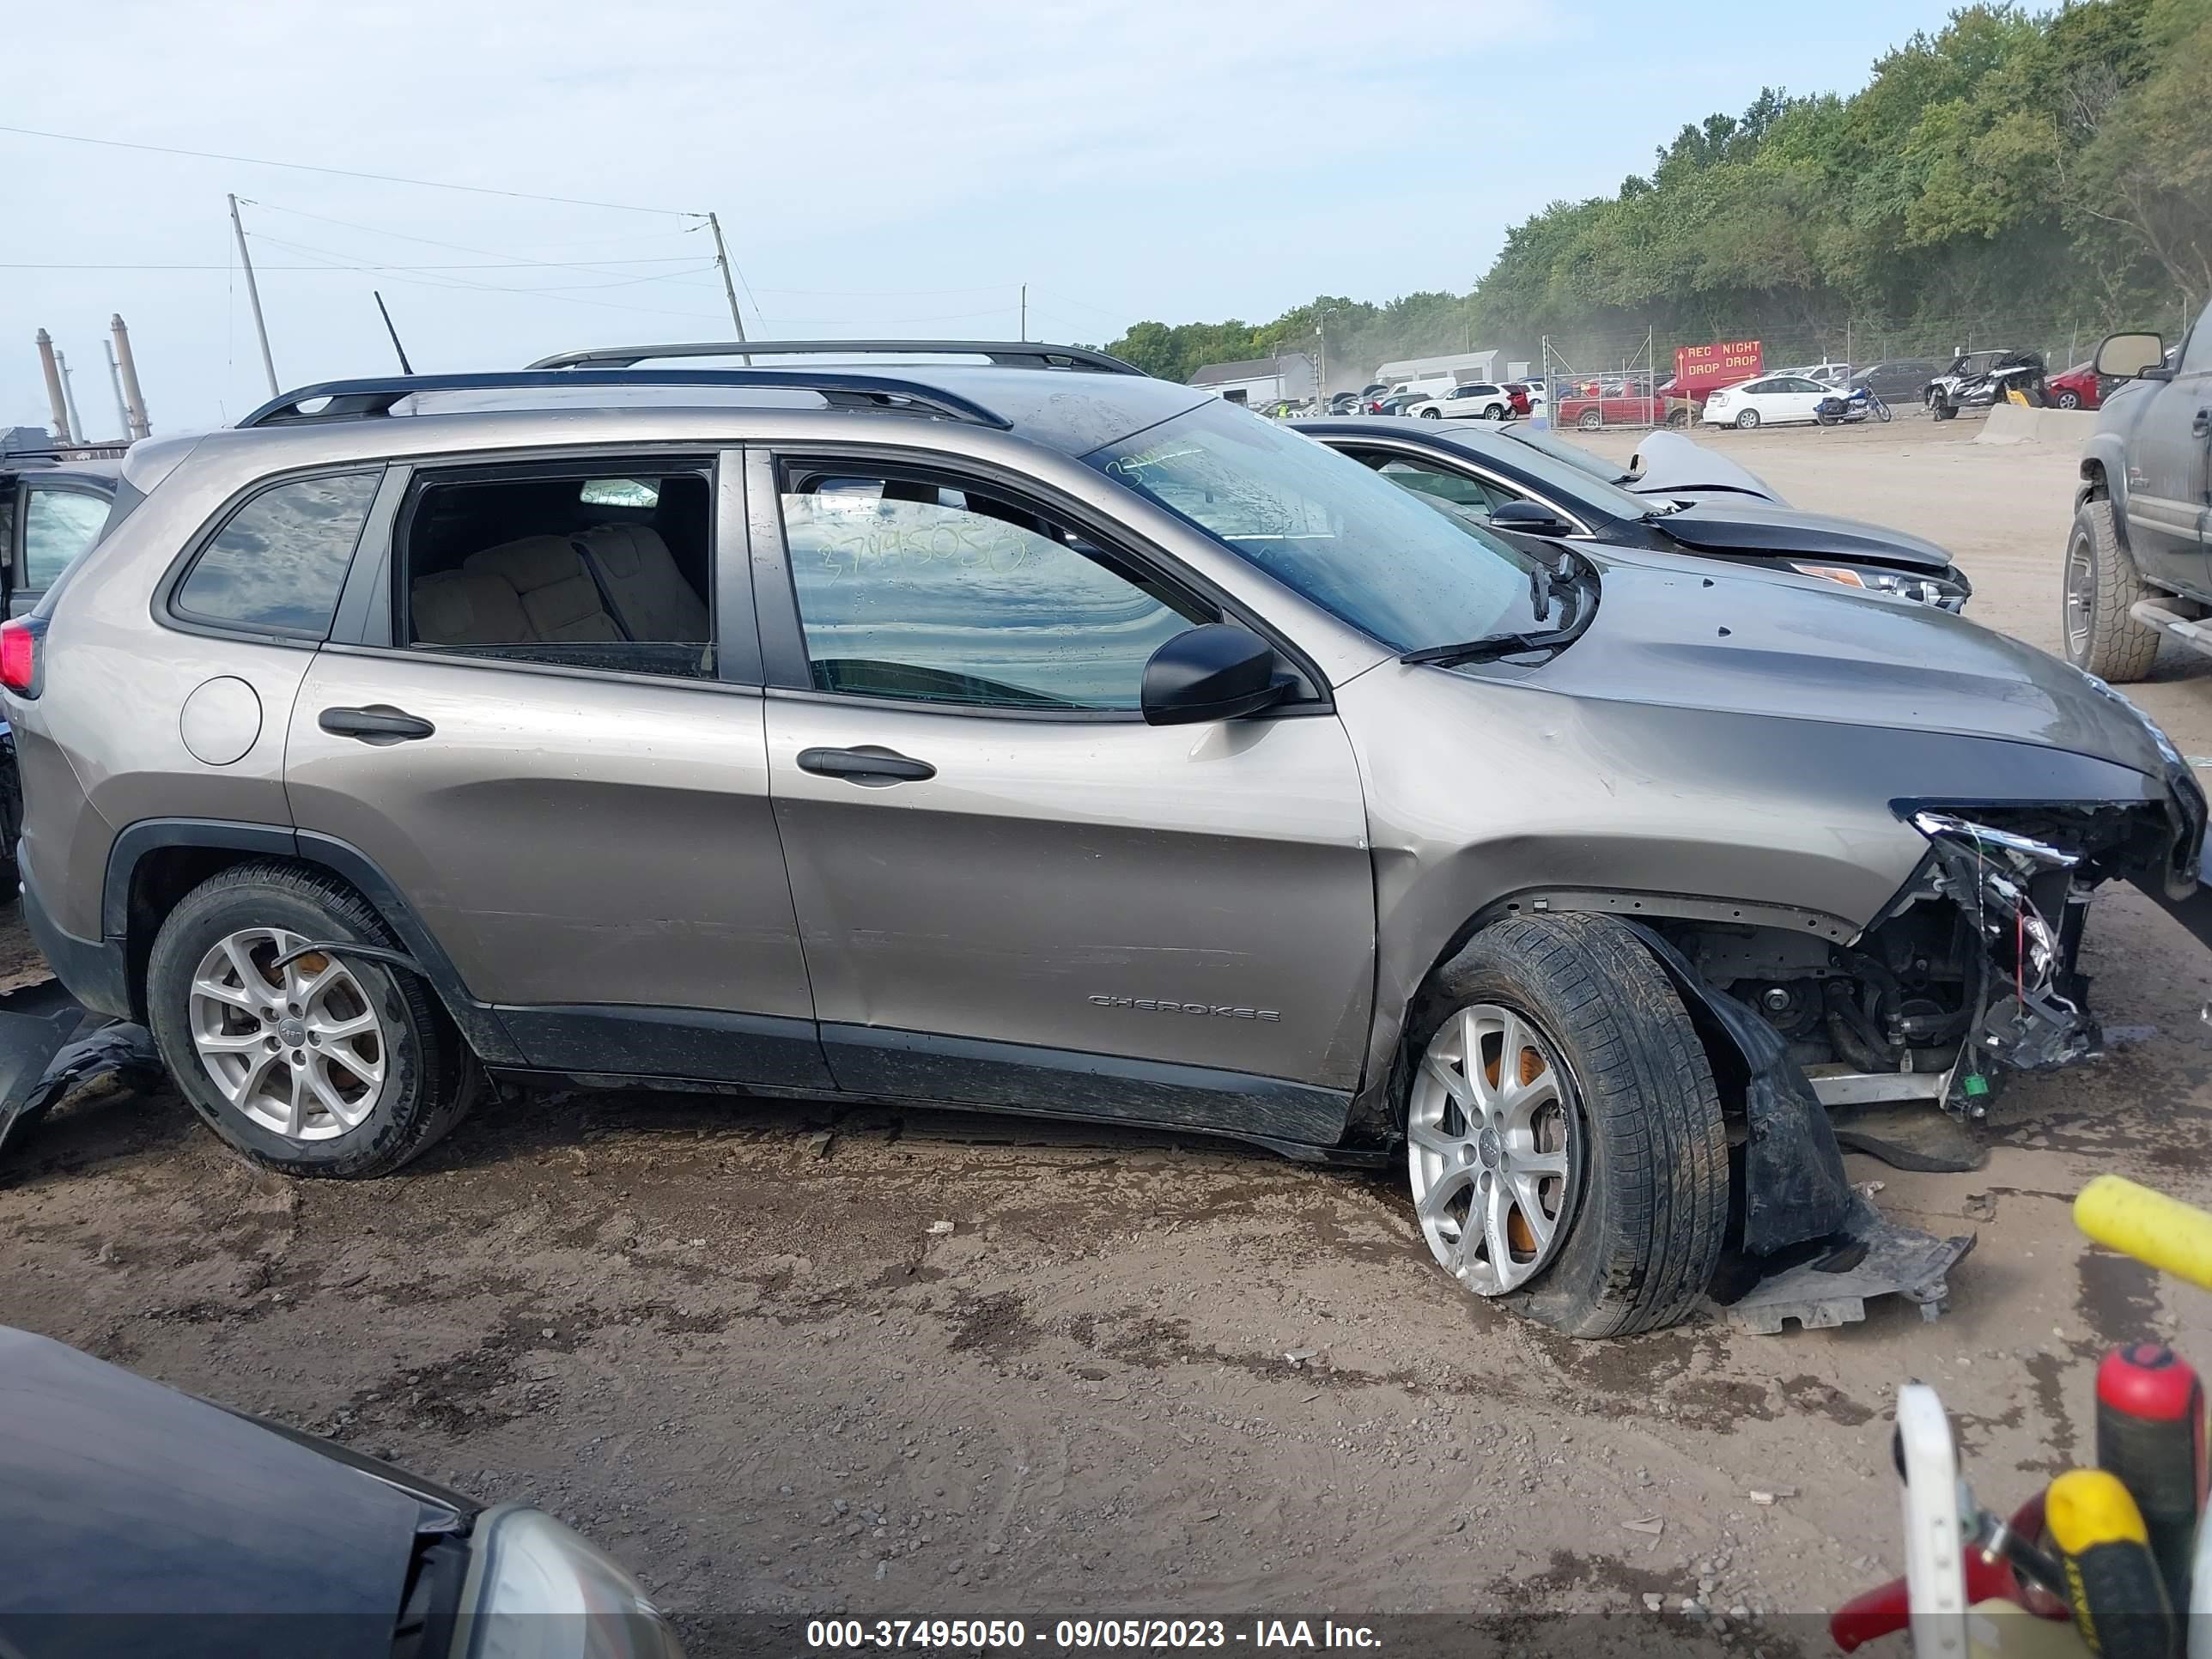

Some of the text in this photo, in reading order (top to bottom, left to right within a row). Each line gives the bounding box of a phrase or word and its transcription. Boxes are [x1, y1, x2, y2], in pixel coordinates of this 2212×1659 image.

[1687, 346, 1711, 358] REG
[1723, 340, 1760, 355] NIGHT
[1725, 355, 1758, 368] DROP
[1688, 362, 1720, 376] DROP
[1087, 994, 1281, 1022] CHEROKEE
